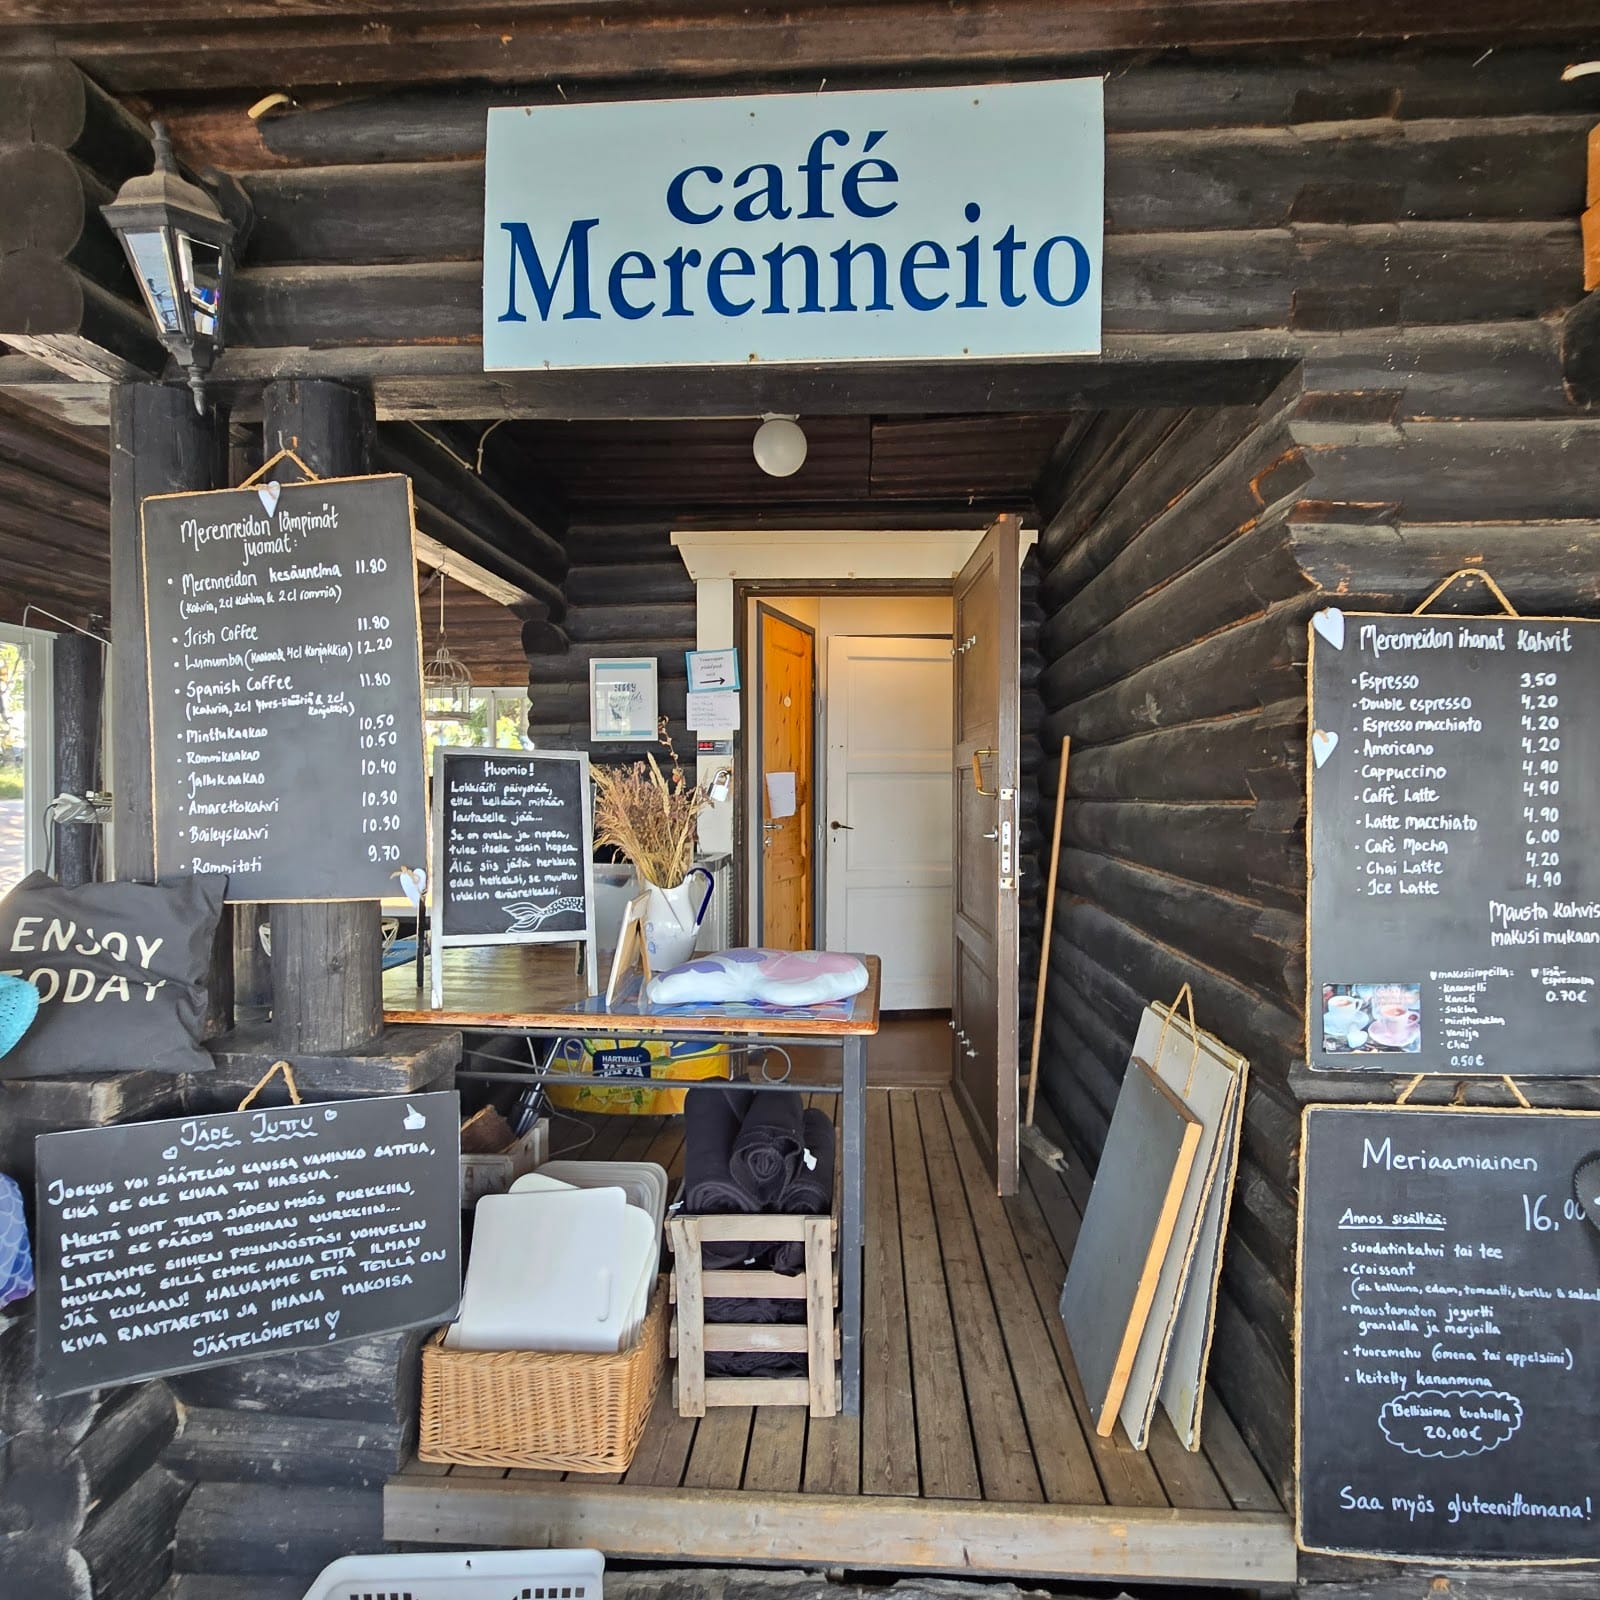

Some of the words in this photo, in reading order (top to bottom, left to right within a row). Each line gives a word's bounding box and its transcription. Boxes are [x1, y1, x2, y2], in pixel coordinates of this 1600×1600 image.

[666, 129, 900, 225] café
[497, 202, 1092, 323] Merenneito
[181, 515, 273, 554] Merenneidon
[279, 503, 338, 536] lämpimät
[243, 533, 297, 566] juomat:
[182, 570, 257, 597] Merenneidon
[269, 563, 342, 583] kesäunelma
[356, 558, 387, 574] 11.80
[184, 627, 215, 647] Irish
[221, 624, 258, 641] Coffee
[358, 616, 389, 631] 11.80
[1360, 625, 1453, 658] Merenneidon
[1459, 627, 1505, 650] ihanat
[185, 653, 243, 670] Lumumba
[358, 637, 392, 654] 12.20
[187, 679, 240, 703] Spanish
[247, 675, 293, 691] Coffee
[360, 672, 390, 687] 11.80
[1360, 672, 1419, 694] Espresso
[1520, 673, 1557, 688] 3.50
[1410, 697, 1471, 715] espresso
[1521, 694, 1558, 710] 4.20
[360, 714, 394, 730] 10.50
[1363, 717, 1413, 738] Espresso
[1522, 715, 1559, 731] 4.20
[361, 732, 396, 748] 10.50
[1363, 739, 1433, 758] Americano
[1522, 737, 1560, 753] 4.20
[362, 759, 396, 775] 10.40
[484, 761, 534, 777] Huomio!
[1362, 765, 1447, 782] Cappuccino
[1522, 760, 1558, 776] 4.90
[363, 790, 397, 807] 10.30
[1404, 787, 1440, 802] Latte
[1523, 780, 1559, 797] 4.90
[1366, 813, 1401, 829] Latte
[1524, 807, 1559, 823] 4.90
[189, 826, 268, 847] Baileyskahvi
[363, 815, 400, 833] 10.30
[515, 831, 530, 842] ja
[1526, 829, 1559, 844] 6.00
[192, 856, 261, 874] Rommitoti
[368, 845, 400, 861] 9.70
[1367, 861, 1396, 875] Chai
[1404, 860, 1443, 874] Latte
[1526, 852, 1559, 867] 4.20
[1368, 879, 1392, 895] Ice
[1399, 880, 1439, 894] Latte
[1526, 872, 1561, 888] 4.90
[10, 917, 163, 969] ENJOY
[0, 968, 167, 1004] ODAY
[1546, 990, 1587, 1002] 0.70€
[1363, 1137, 1537, 1171] Meriaamiainen
[124, 1178, 148, 1190] VOI
[303, 1148, 366, 1165] VAHINKO
[138, 1193, 170, 1207] OLE
[179, 1184, 228, 1201] KIVAA
[233, 1180, 259, 1191] TAI
[1339, 1208, 1383, 1224] Annos
[1392, 1212, 1447, 1224] sisältää:
[371, 1236, 420, 1254] ILMAN
[421, 1249, 446, 1262] ON
[1351, 1242, 1445, 1257] suodatinkahvi
[1454, 1244, 1472, 1257] tai
[1479, 1243, 1503, 1259] tee
[1350, 1262, 1415, 1276] croissant
[61, 1333, 107, 1353] KIVA
[115, 1305, 232, 1344] RANTARETKI
[237, 1303, 257, 1318] JA
[272, 1289, 325, 1311] IHANA
[342, 1274, 413, 1295] MAKOISA
[1350, 1302, 1436, 1317] maustamaton
[1445, 1305, 1493, 1323] jogurtti
[1359, 1320, 1419, 1336] granolalla
[1424, 1325, 1440, 1338] ja
[1445, 1321, 1501, 1339] marjoilla
[1353, 1344, 1421, 1358] tuoremehu
[1432, 1343, 1476, 1362] (omena
[1482, 1349, 1500, 1360] tai
[1506, 1348, 1573, 1370] appelsiini)
[1356, 1369, 1407, 1391] keitetty
[1416, 1370, 1492, 1387] kananmuna
[1460, 1406, 1510, 1422] kuohulla
[1340, 1486, 1384, 1510] Saa
[1392, 1494, 1435, 1522] myös
[1448, 1493, 1591, 1523] gluteenittomana!
